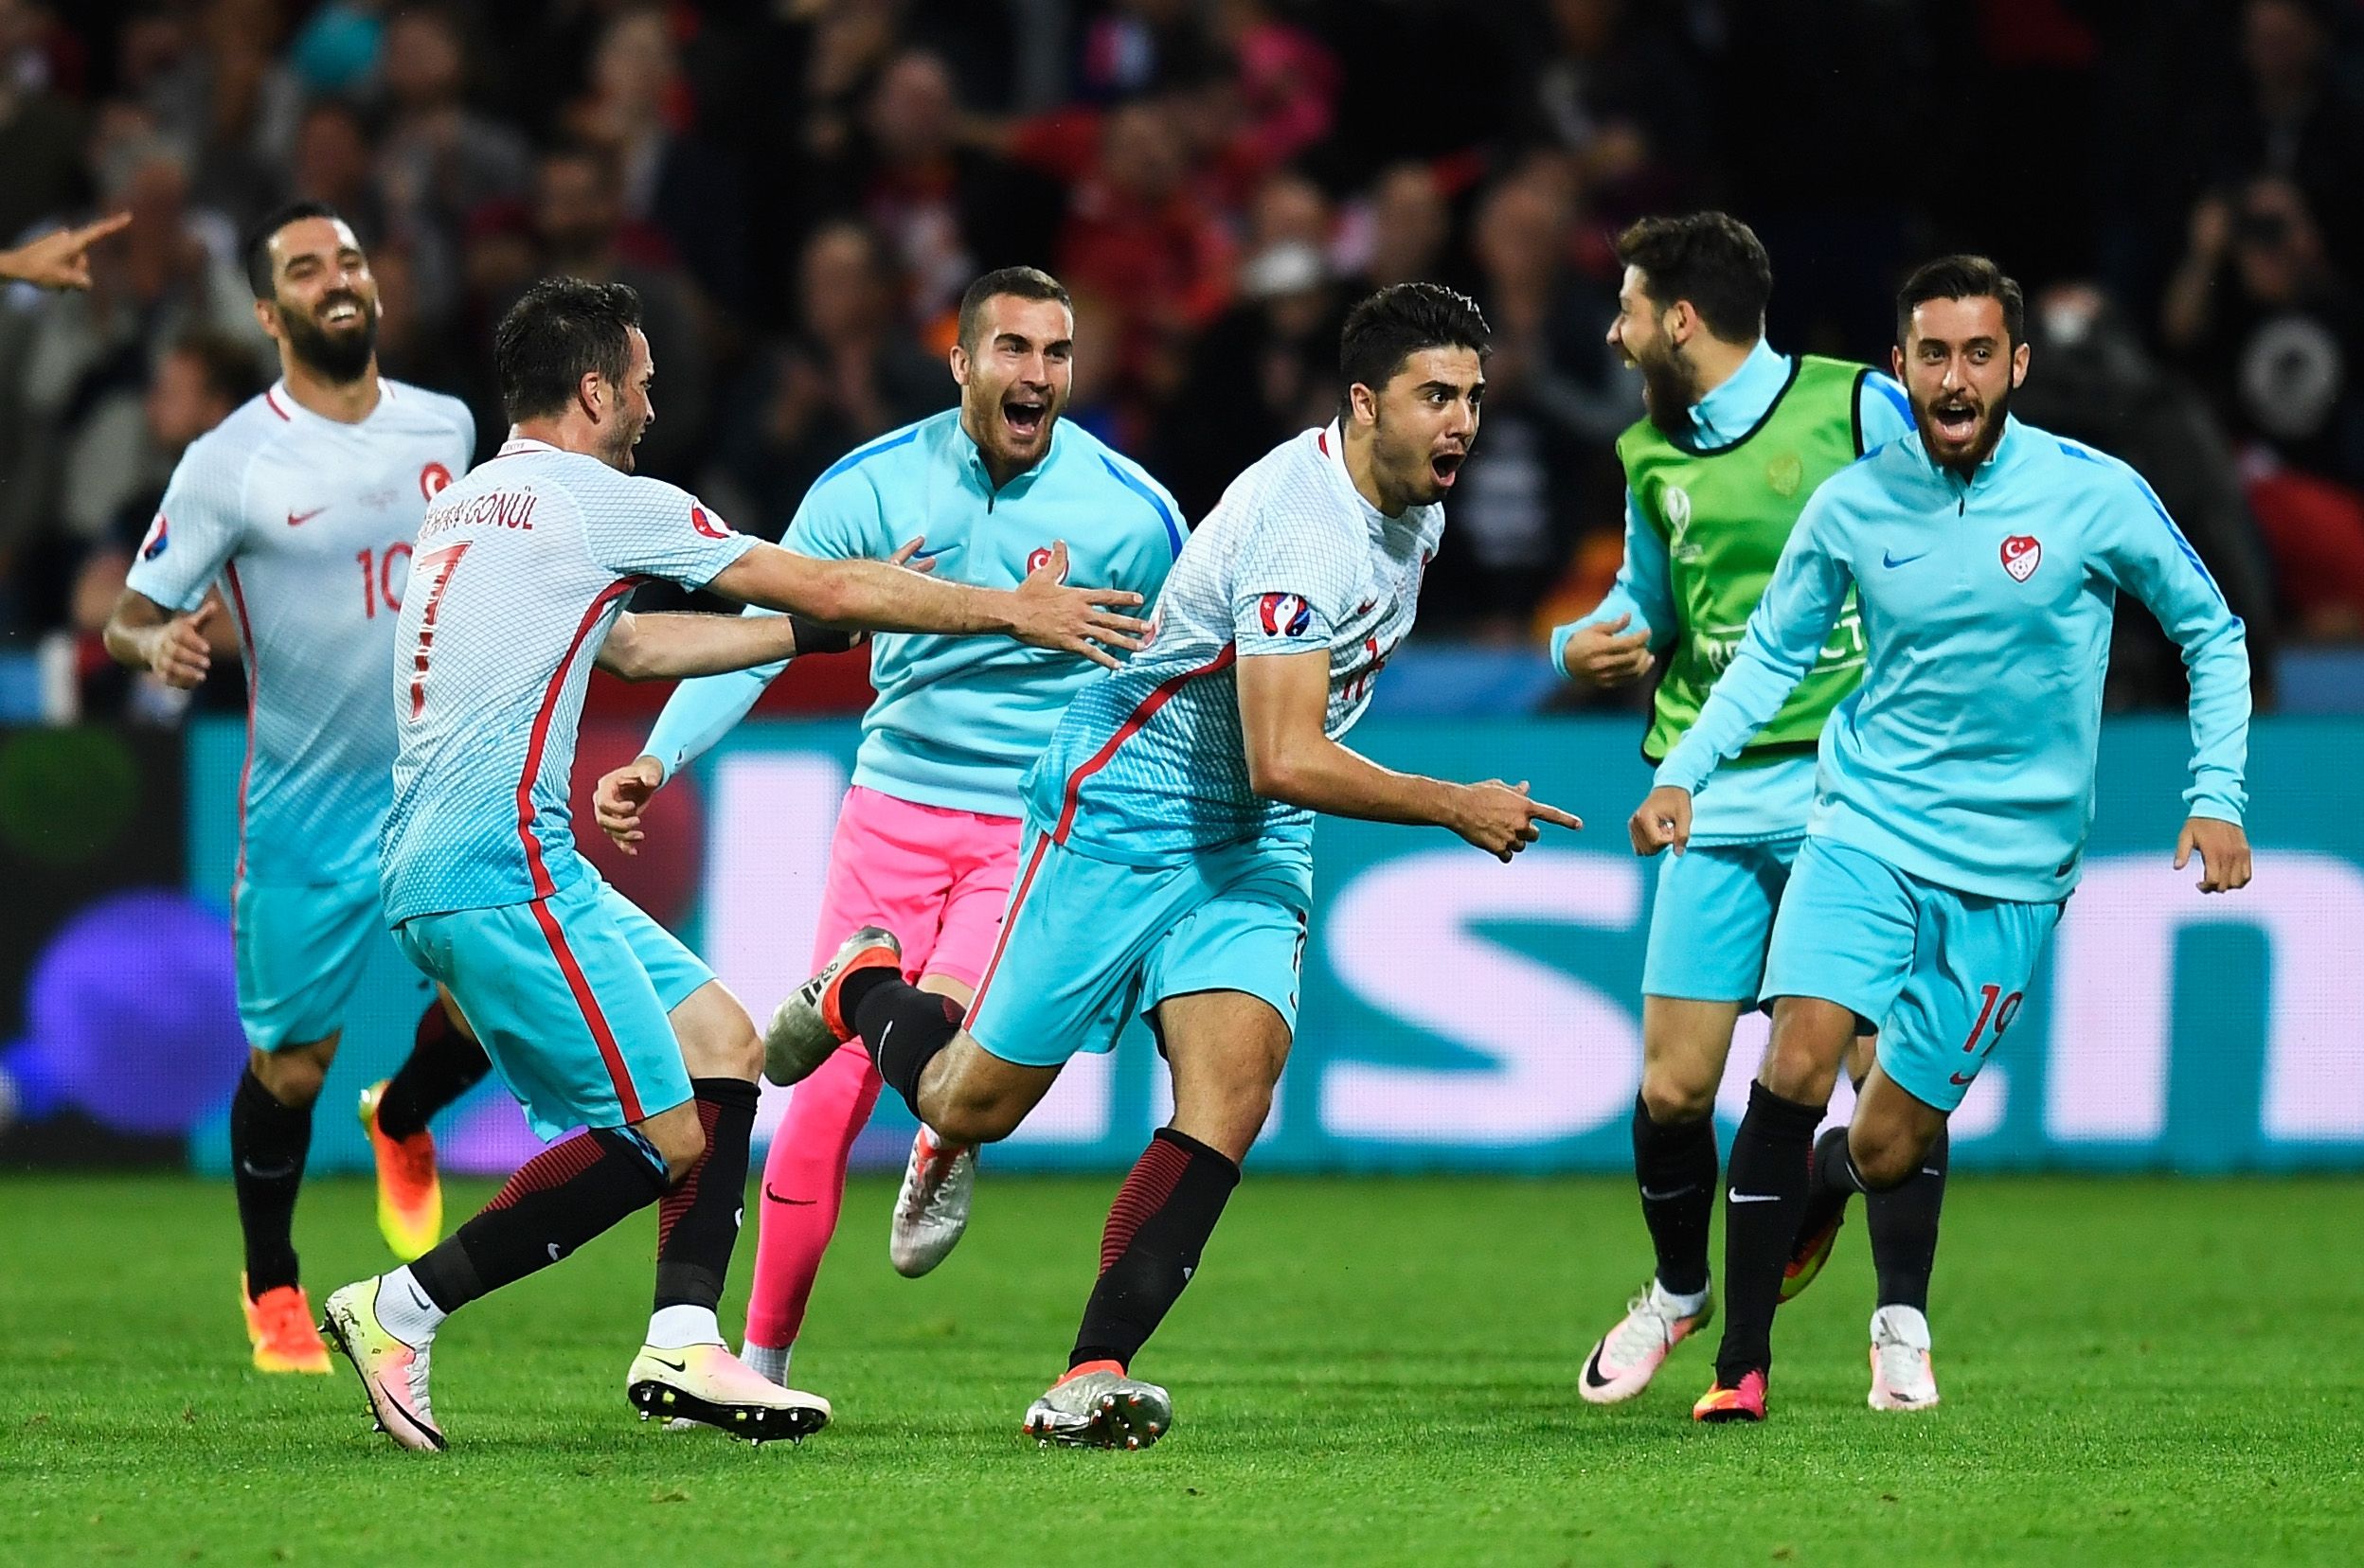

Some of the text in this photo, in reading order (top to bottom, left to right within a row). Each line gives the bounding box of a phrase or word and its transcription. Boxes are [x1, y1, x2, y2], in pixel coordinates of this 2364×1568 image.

[356, 541, 413, 619] 10
[409, 541, 474, 724] 7
[1962, 984, 2024, 1054] 19
